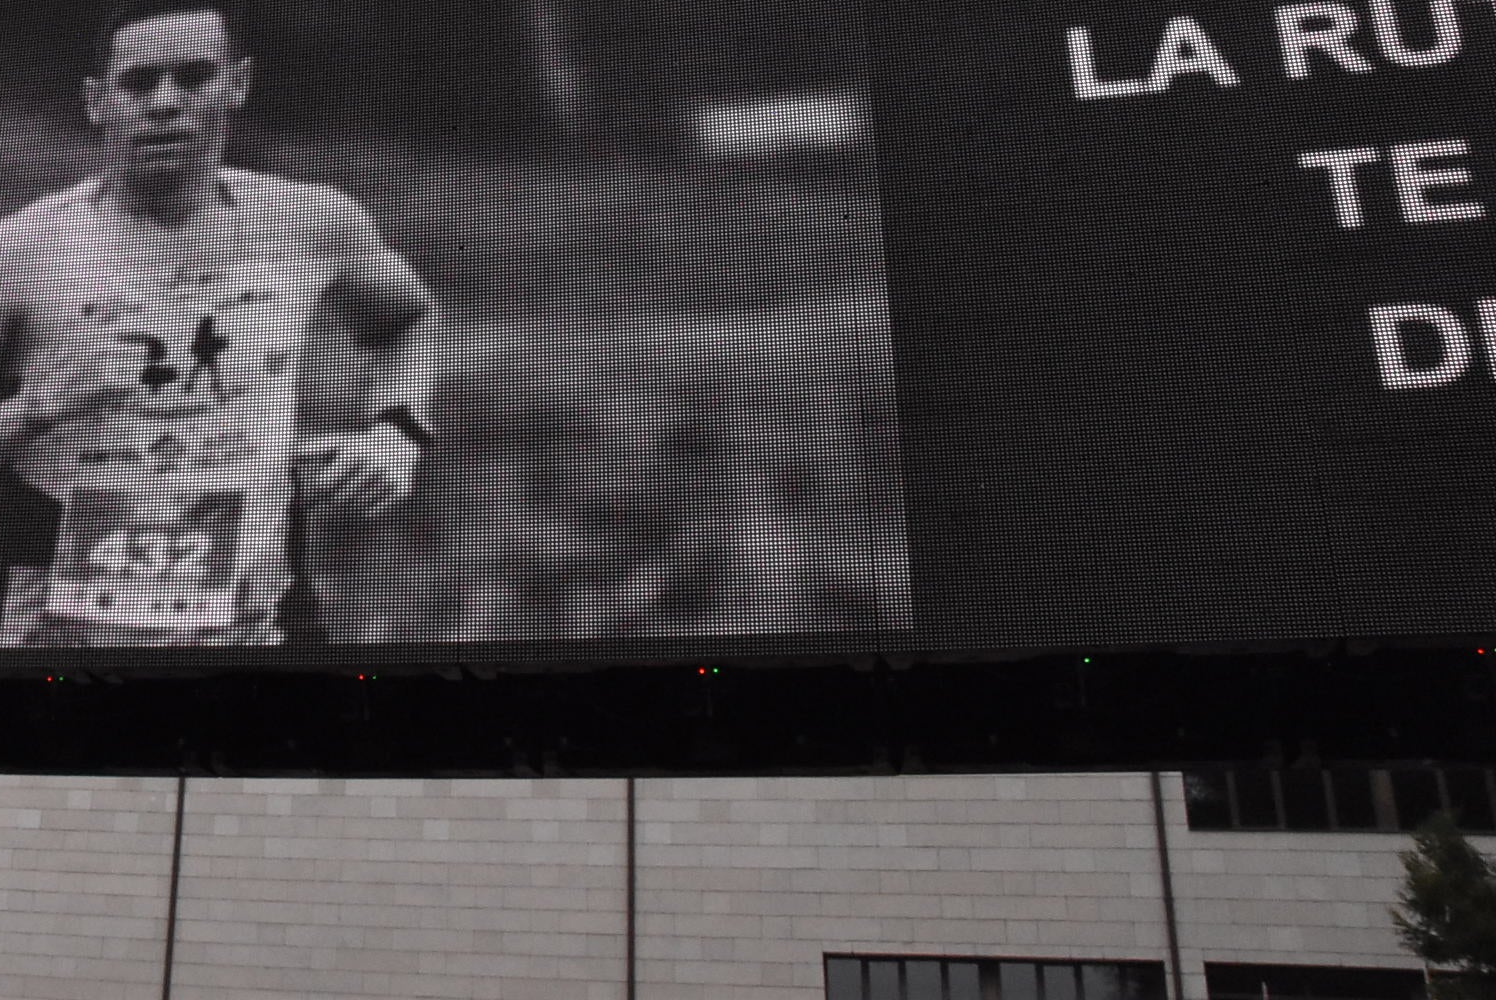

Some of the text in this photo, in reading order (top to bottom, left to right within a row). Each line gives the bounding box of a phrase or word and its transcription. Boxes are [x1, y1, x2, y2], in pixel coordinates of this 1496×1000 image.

[1067, 15, 1241, 99] LA
[1298, 139, 1486, 230] TE
[87, 530, 213, 577] 432
